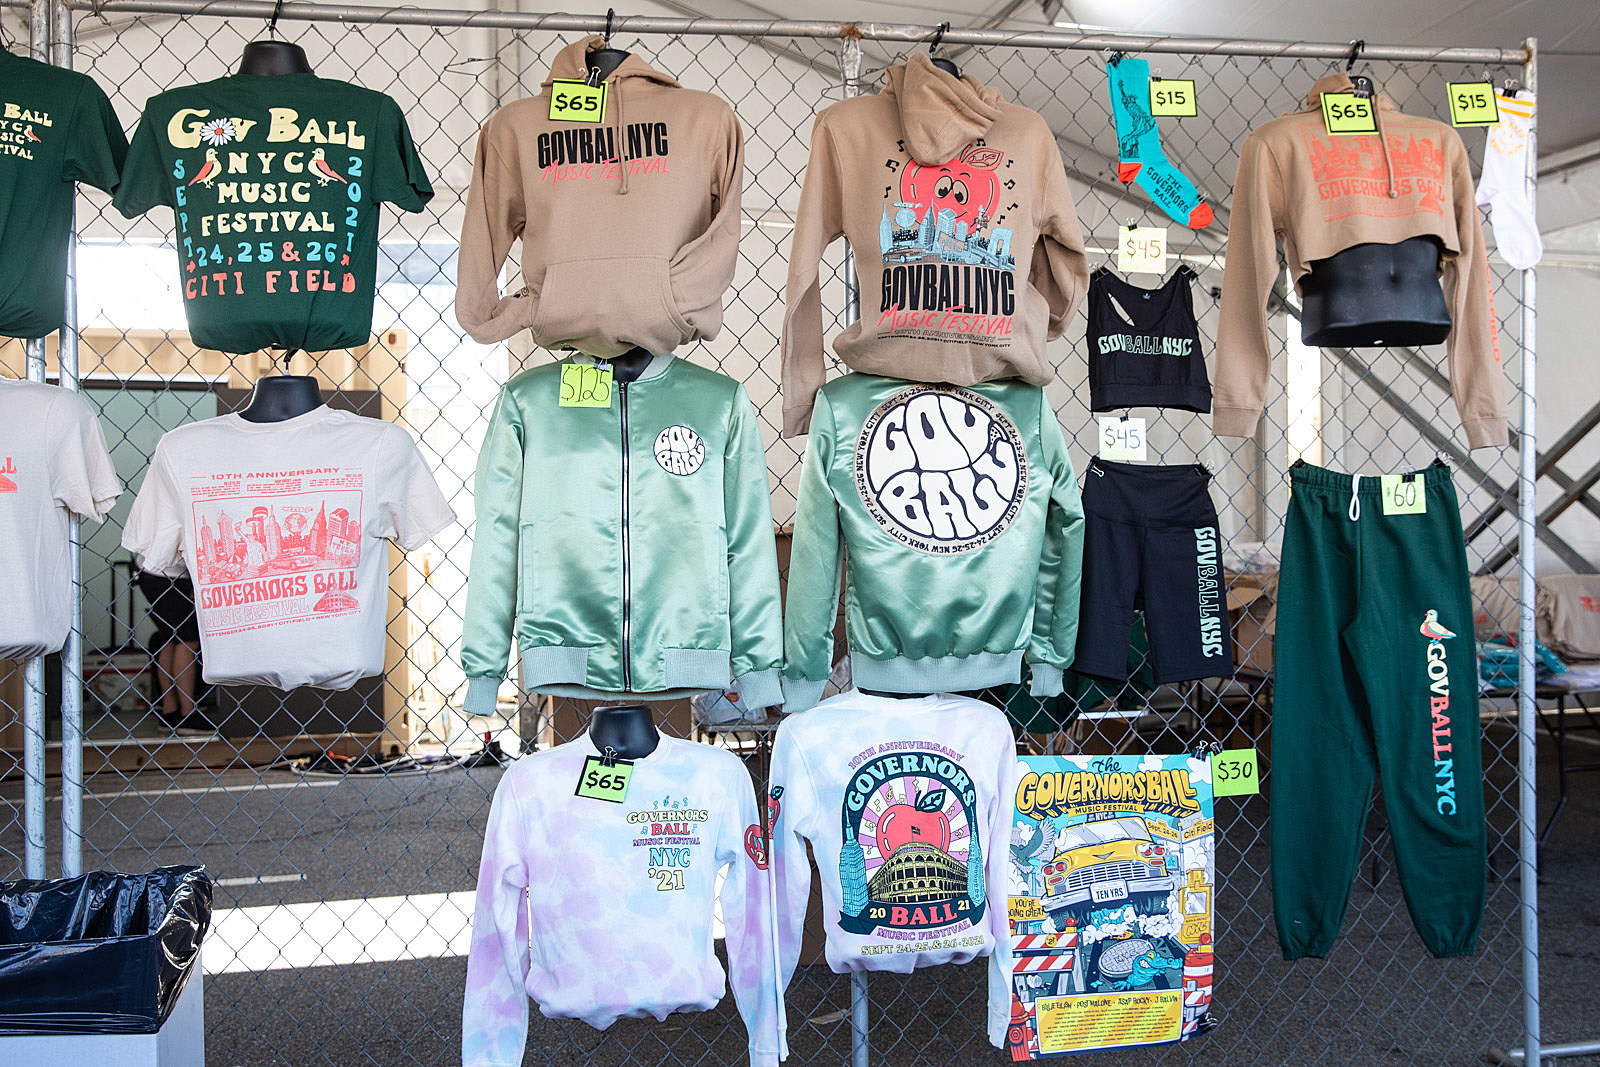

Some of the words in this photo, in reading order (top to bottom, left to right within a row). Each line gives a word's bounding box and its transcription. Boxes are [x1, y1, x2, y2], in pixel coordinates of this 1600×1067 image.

[554, 92, 598, 112] $65
[1156, 91, 1186, 107] $15
[1458, 94, 1487, 110] $15
[4, 102, 53, 127] BALL
[1331, 104, 1368, 120] $65
[228, 151, 304, 175] NYC
[217, 182, 311, 204] MUSIC
[1146, 166, 1189, 214] GOVERNORS
[1167, 173, 1183, 191] THE
[1154, 187, 1171, 208] BALL
[201, 211, 335, 237] FESTIVAL
[306, 241, 337, 263] 26
[1126, 238, 1161, 259] $45
[185, 271, 245, 300] CITI
[266, 269, 356, 294] FIELD
[880, 264, 1015, 316] GOVBALLNYC
[1098, 334, 1193, 356] GOVBALLNYC
[561, 365, 609, 402] $125
[881, 398, 898, 411] SEPT
[955, 389, 974, 400] YORK
[975, 397, 994, 411] CITY
[653, 425, 699, 453] GOV
[858, 430, 869, 450] YORK
[866, 411, 880, 429] CITY
[1105, 426, 1140, 449] $45
[869, 394, 993, 493] GOV
[656, 444, 705, 476] BALL
[246, 467, 340, 479] ANNIVERSARY
[877, 436, 1018, 540] BALL
[1015, 485, 1026, 505] YORK
[1005, 506, 1018, 523] CITY
[200, 575, 308, 609] GOVERNORS
[313, 571, 358, 594] BALL
[1194, 526, 1223, 658] GOVBALLNYC
[203, 608, 242, 628] MUSIC
[244, 598, 310, 622] FESTIVAL
[1426, 643, 1457, 816] GOVBALLNYC
[848, 747, 876, 769] 10TH
[879, 741, 965, 762] ANNIVERSARY
[585, 770, 626, 791] $65
[1218, 760, 1253, 782] $30
[847, 754, 976, 812] GOVERNORS
[627, 809, 708, 824] GOVERNORS
[1075, 805, 1101, 814] MUSIC
[1103, 804, 1138, 812] FESTIVAL
[1095, 811, 1108, 821] NYC
[651, 823, 690, 836] BALL
[1184, 828, 1195, 839] Citi
[1197, 820, 1212, 834] Field
[633, 837, 663, 846] MUSIC
[665, 837, 700, 846] FESTIVAL
[649, 848, 690, 868] NYC
[648, 868, 684, 891] '21
[1015, 898, 1036, 908] YOU'RE
[1096, 890, 1109, 900] TEN
[1110, 888, 1124, 897] YRS
[869, 908, 886, 919] 20
[889, 903, 958, 926] BALL
[958, 900, 970, 911] 21
[1026, 907, 1044, 918] GREAT
[877, 928, 916, 940] MUSIC
[918, 920, 971, 940] FESTIVAL
[861, 945, 893, 956] SEPT
